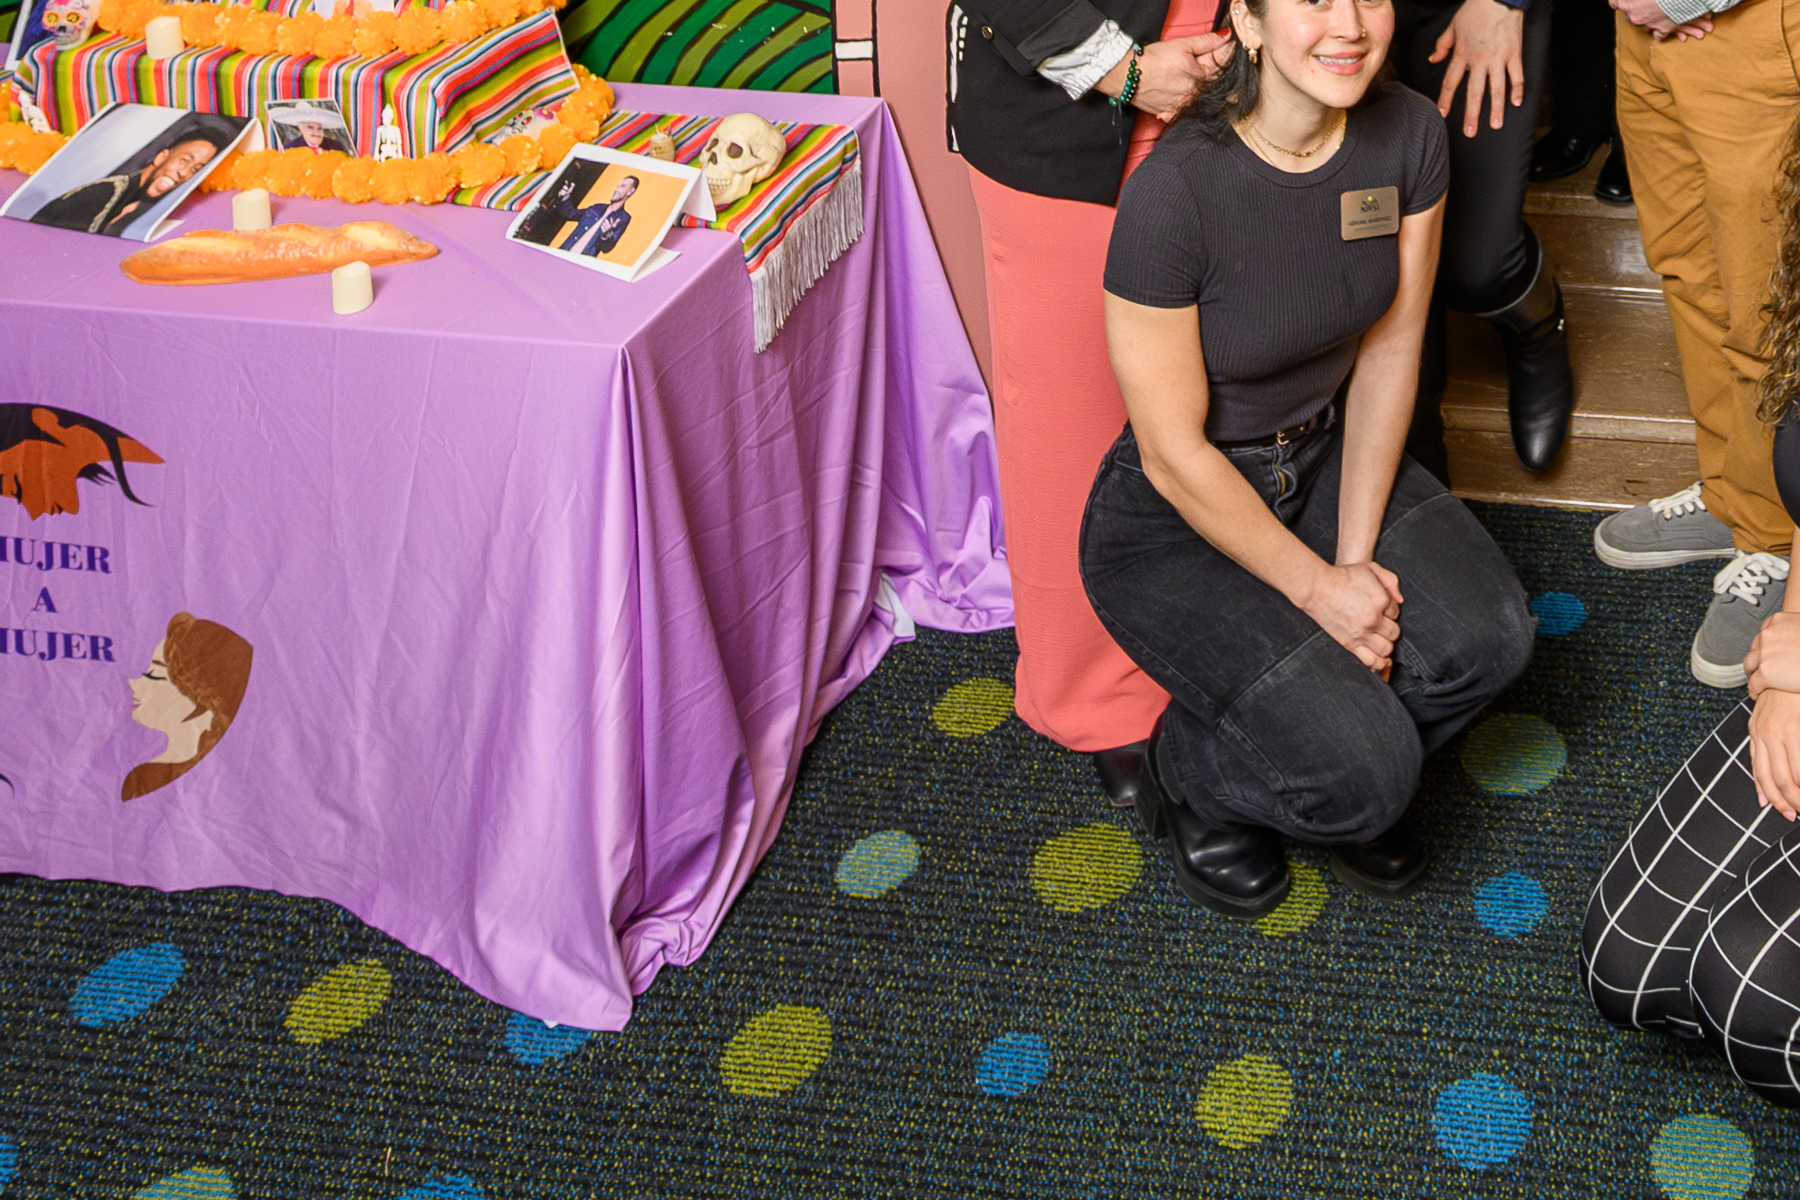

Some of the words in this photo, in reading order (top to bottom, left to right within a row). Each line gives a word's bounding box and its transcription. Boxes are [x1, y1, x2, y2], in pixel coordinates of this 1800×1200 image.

[0, 535, 112, 574] UJER
[33, 586, 58, 614] A
[0, 627, 116, 663] UJER
